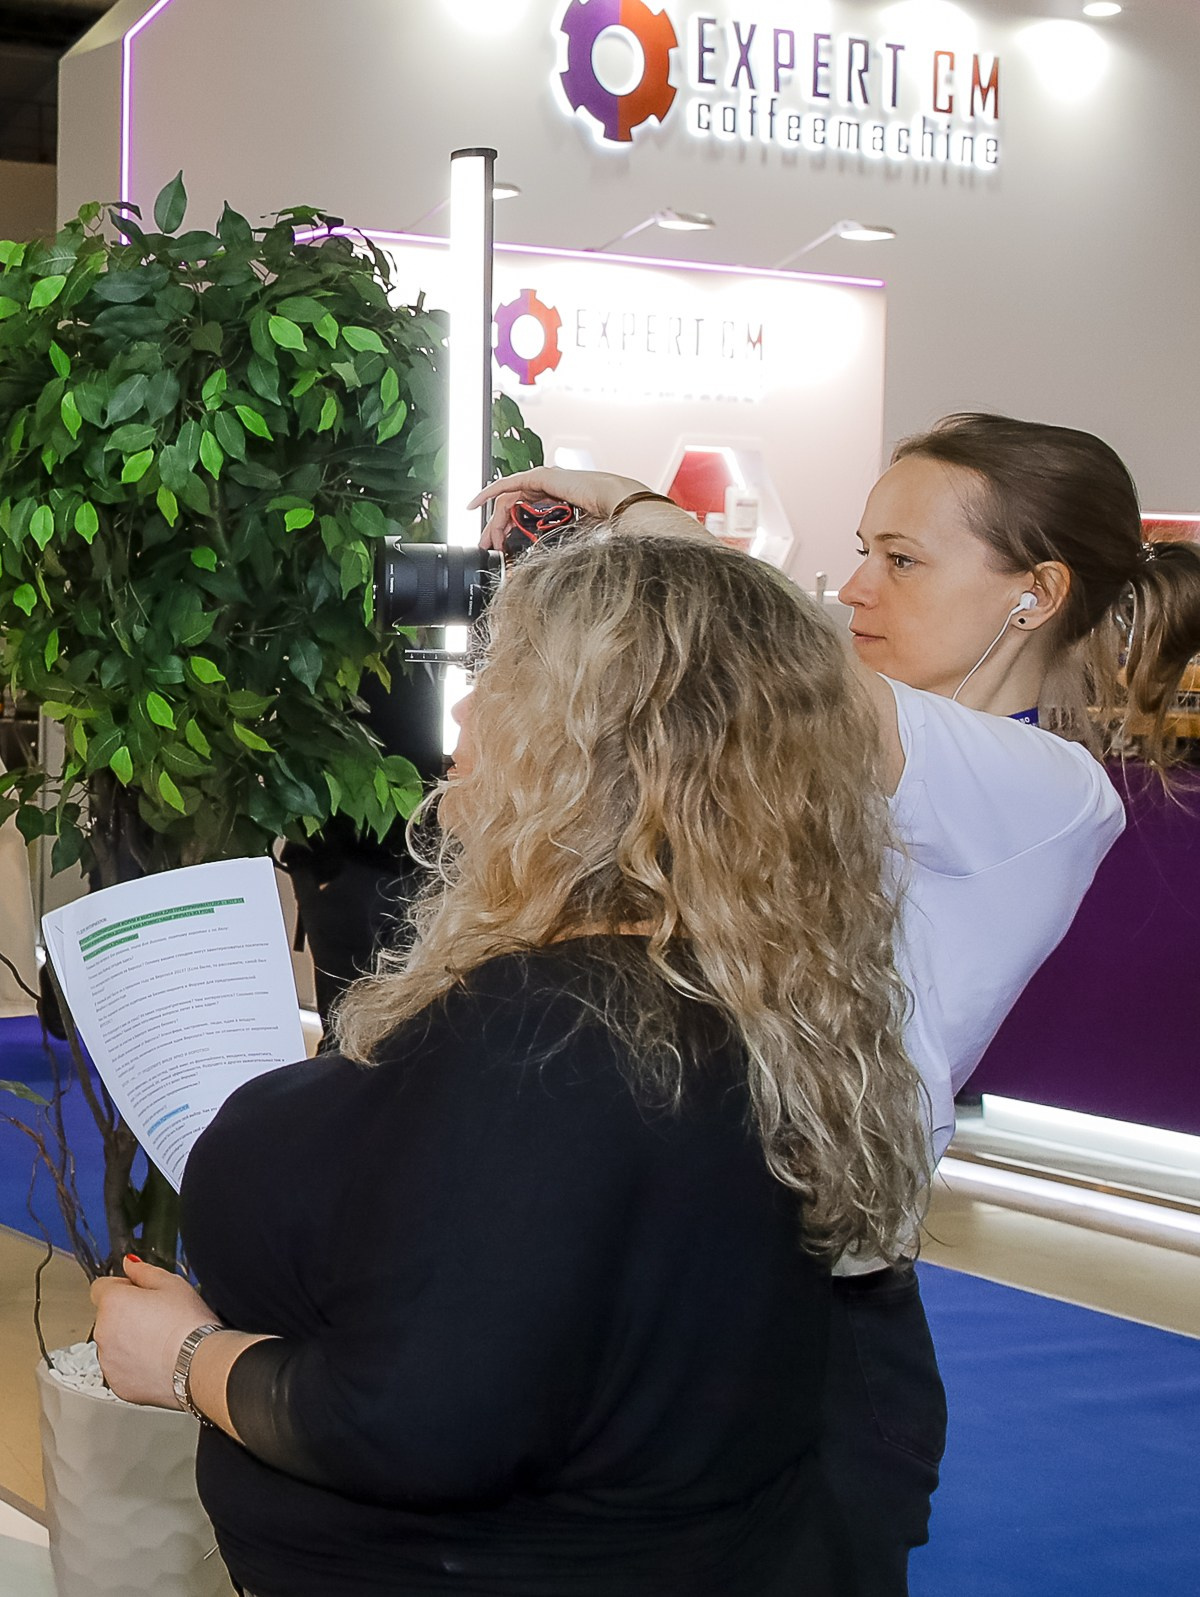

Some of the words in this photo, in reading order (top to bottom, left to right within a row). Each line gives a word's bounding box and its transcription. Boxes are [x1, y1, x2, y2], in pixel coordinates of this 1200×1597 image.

[697, 17, 905, 108] EXPERT
[932, 50, 1000, 120] CM
[697, 95, 999, 164] coffeemachine
[575, 308, 705, 356] EXPERT
